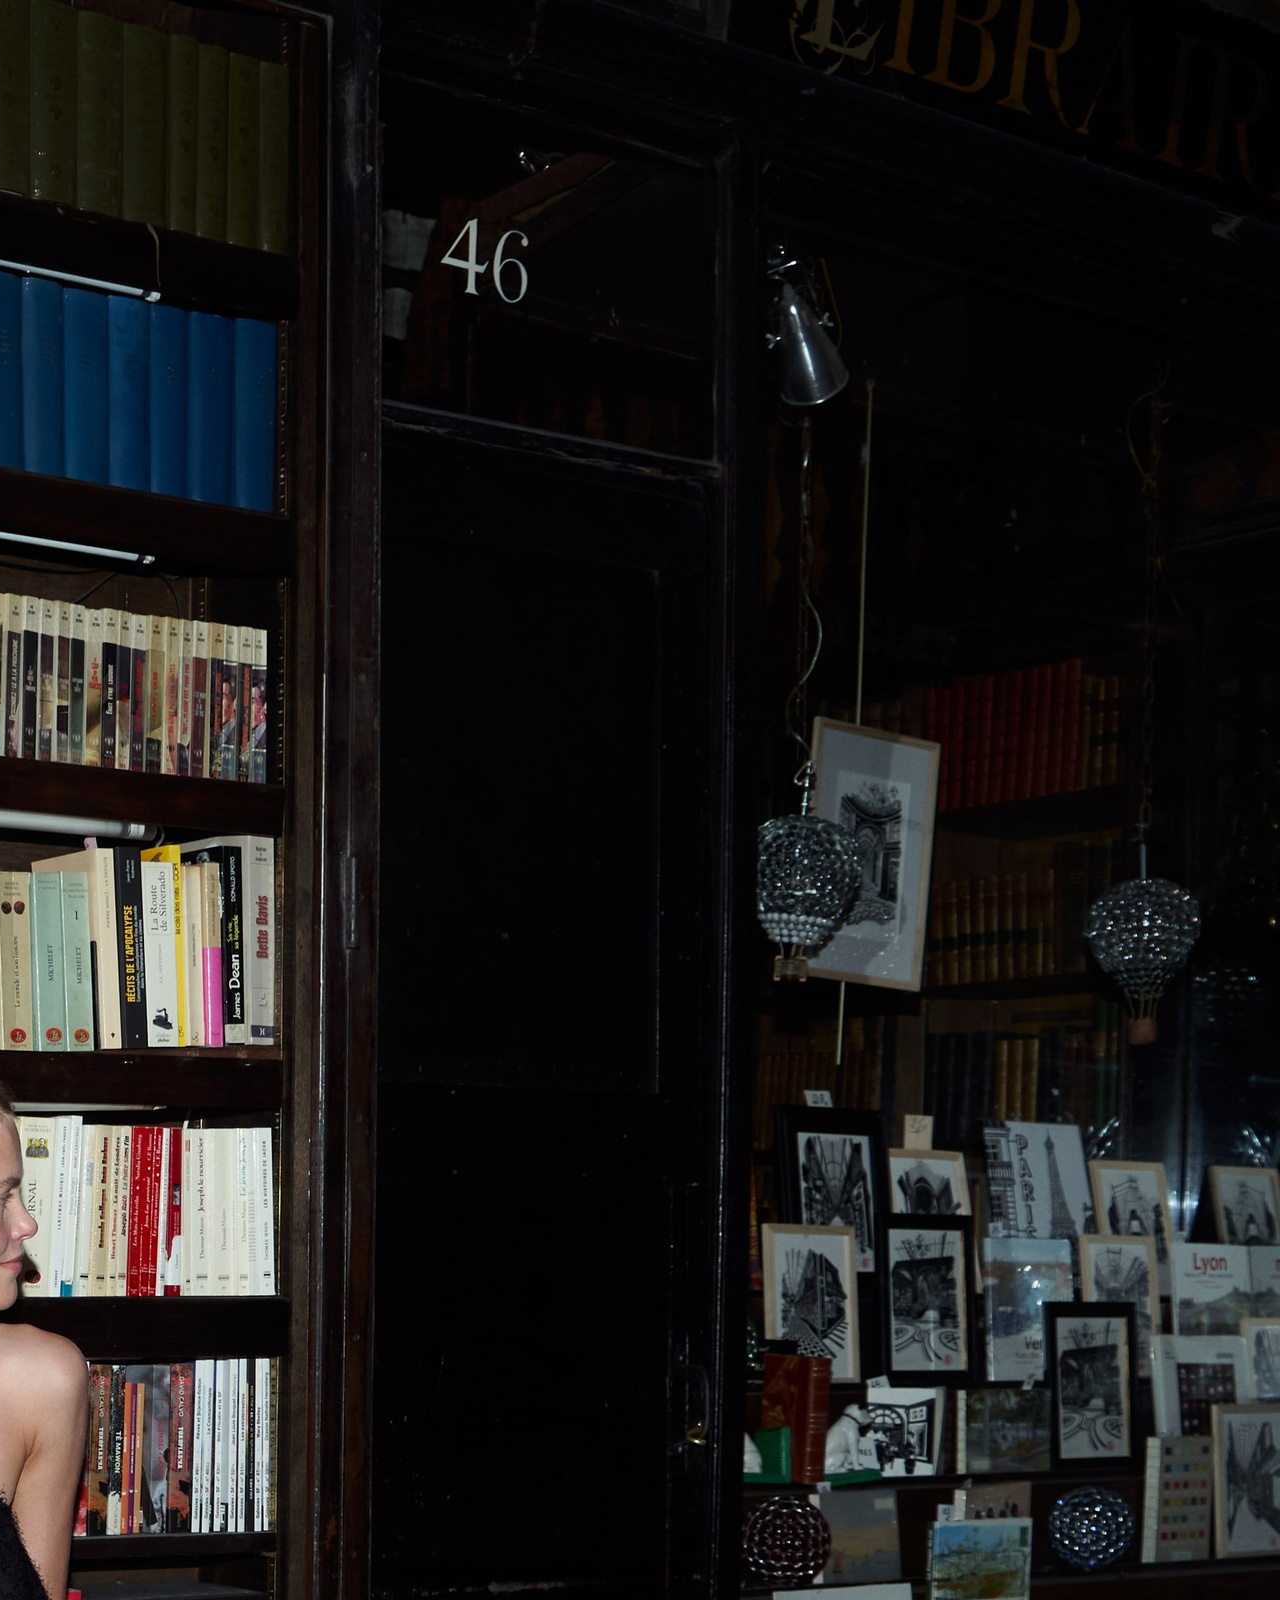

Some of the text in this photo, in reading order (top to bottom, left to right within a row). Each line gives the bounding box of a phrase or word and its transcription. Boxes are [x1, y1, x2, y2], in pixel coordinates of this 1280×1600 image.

[788, 0, 1280, 198] LIBRAIR
[441, 218, 529, 303] 46
[149, 885, 159, 931] La Route
[158, 871, 168, 932] de Silverado
[255, 895, 269, 959] Bette Davis
[75, 946, 83, 985] MICHELET
[123, 905, 136, 1003] RÉCITS DE L'APOCALYPSE
[228, 954, 241, 1020] James Dean
[1193, 1252, 1228, 1275] Lyon
